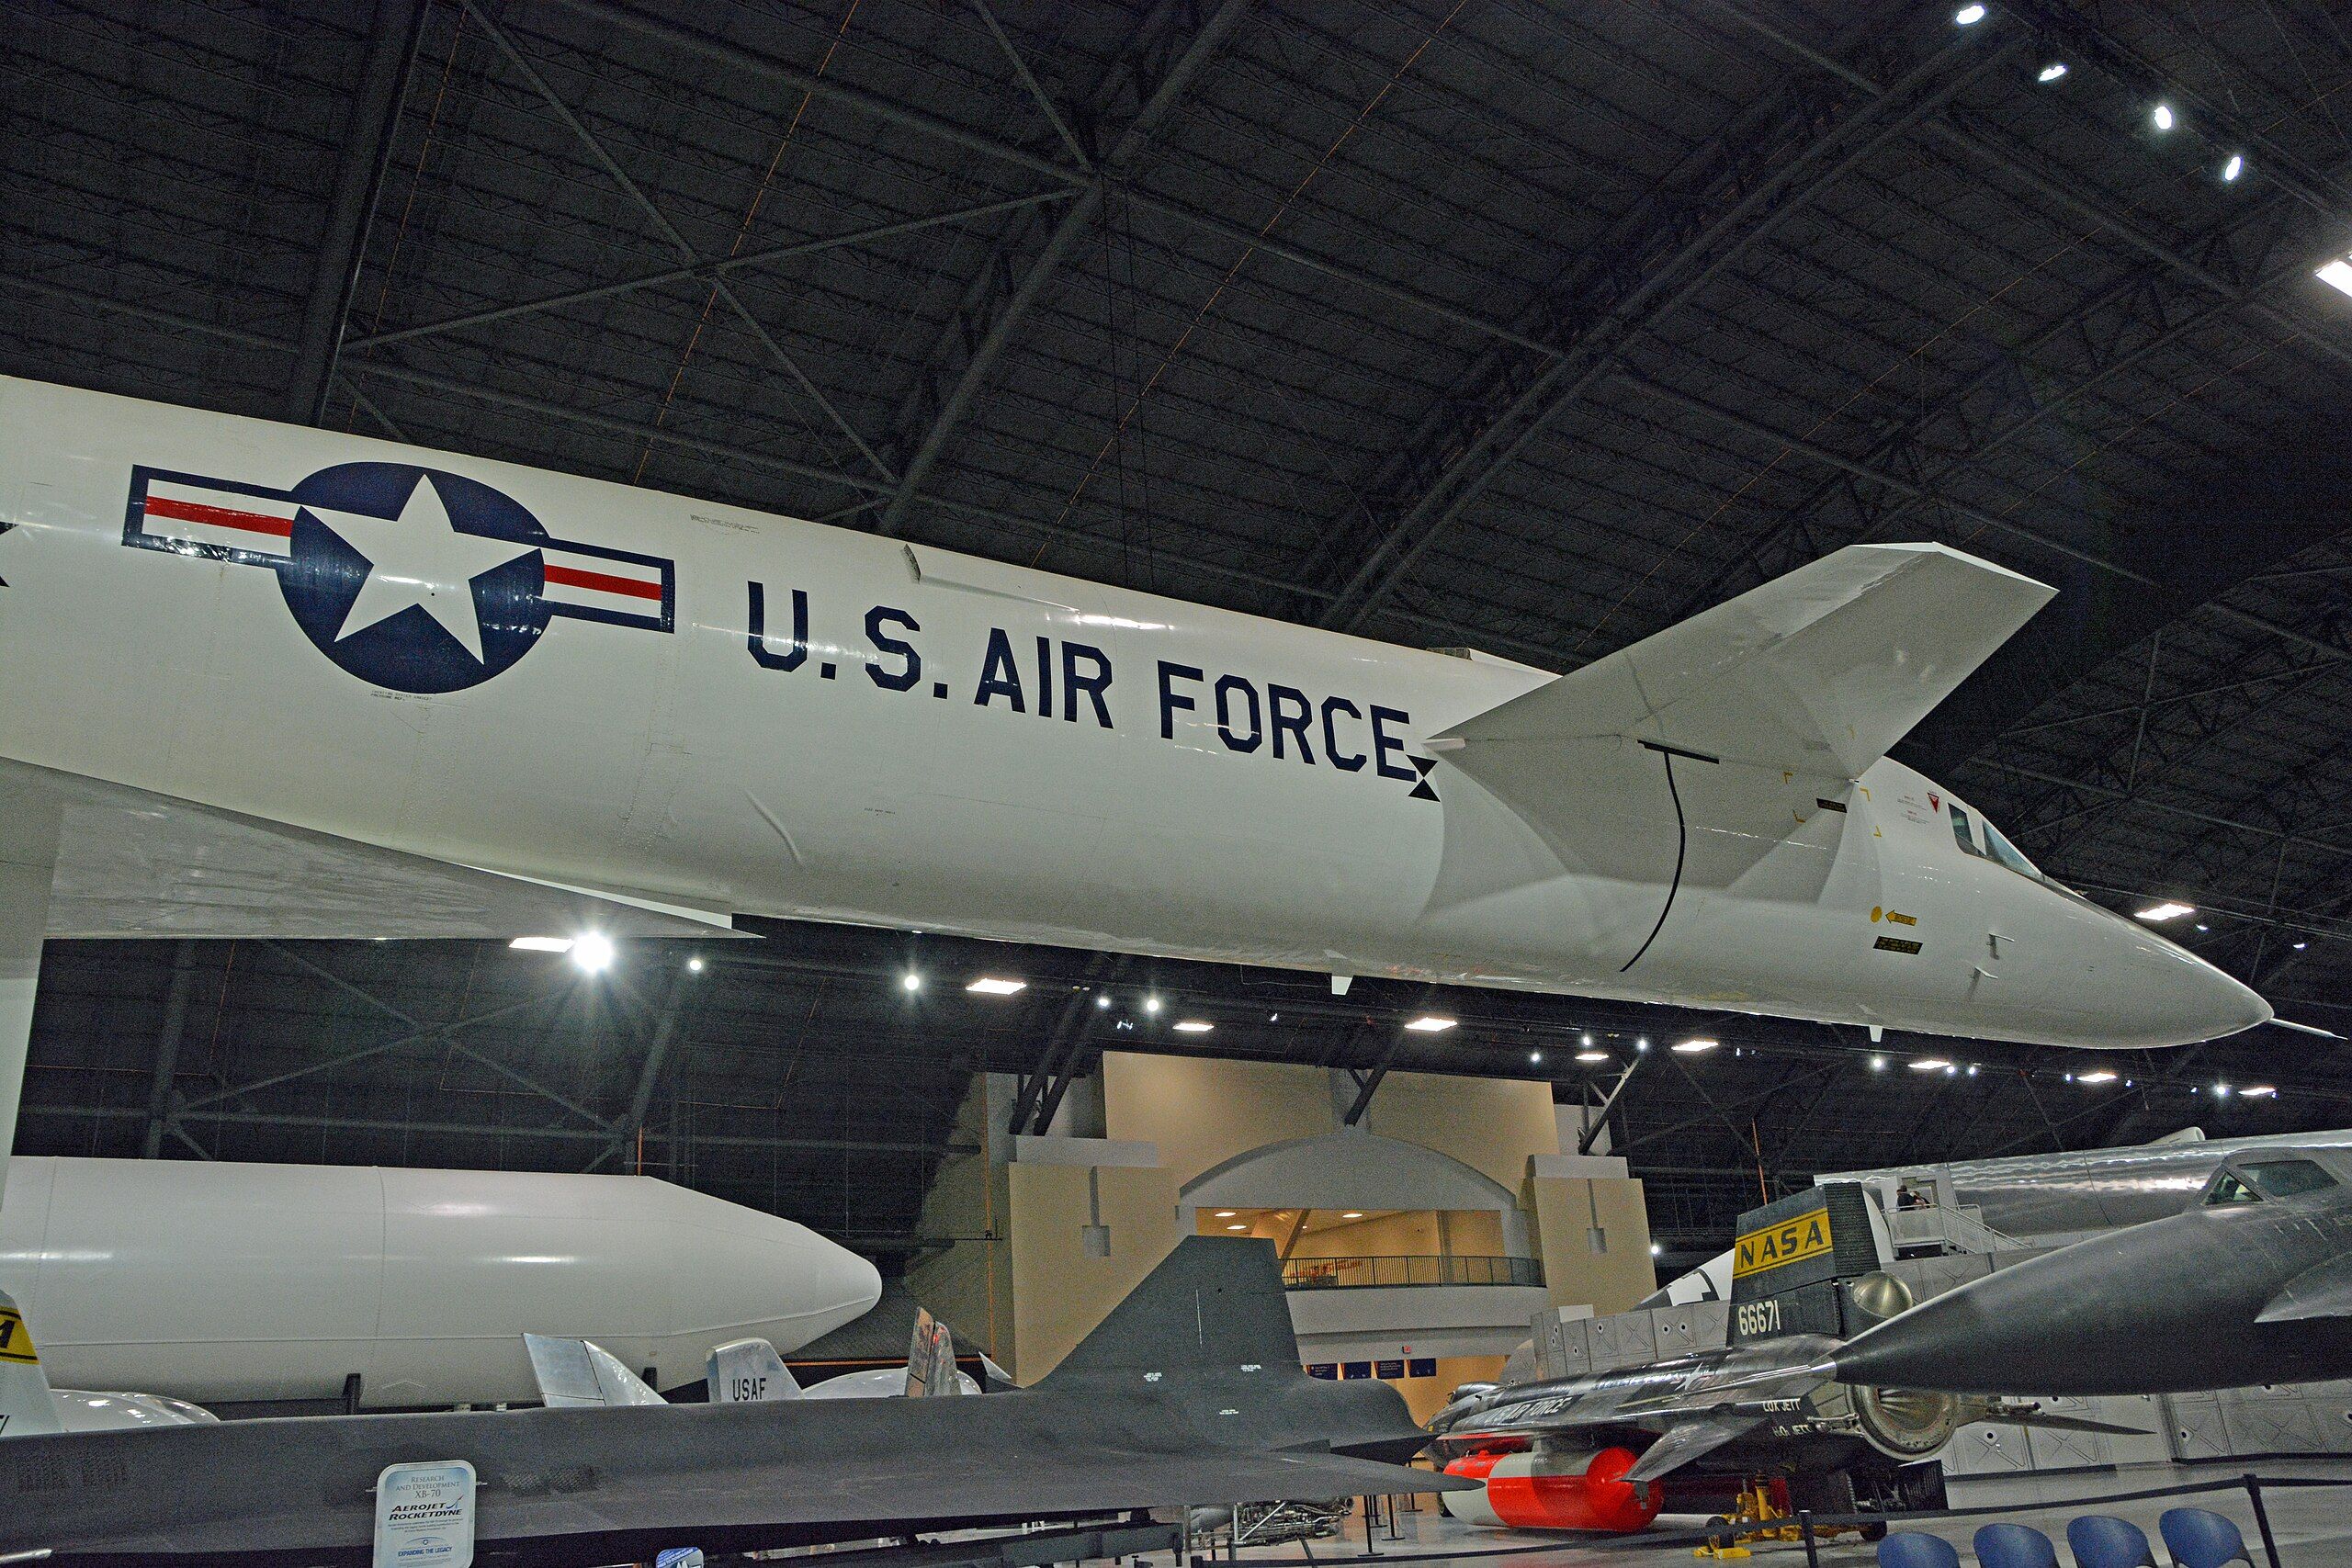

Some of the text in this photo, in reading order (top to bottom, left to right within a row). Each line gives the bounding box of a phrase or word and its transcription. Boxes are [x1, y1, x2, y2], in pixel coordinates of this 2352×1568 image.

[748, 581, 1417, 783] U.S. AIR FORCE
[1740, 1220, 1824, 1269] NASA
[1738, 1300, 1781, 1336] 66671
[732, 1378, 766, 1402] USAF
[1525, 1397, 1573, 1416] FORCE
[411, 1475, 445, 1483] RESEARCH
[413, 1481, 460, 1491] DEVELOPMENT
[414, 1489, 441, 1499] XB-70
[389, 1509, 463, 1521] ROCKETDYNE
[392, 1502, 447, 1513] AEROJET
